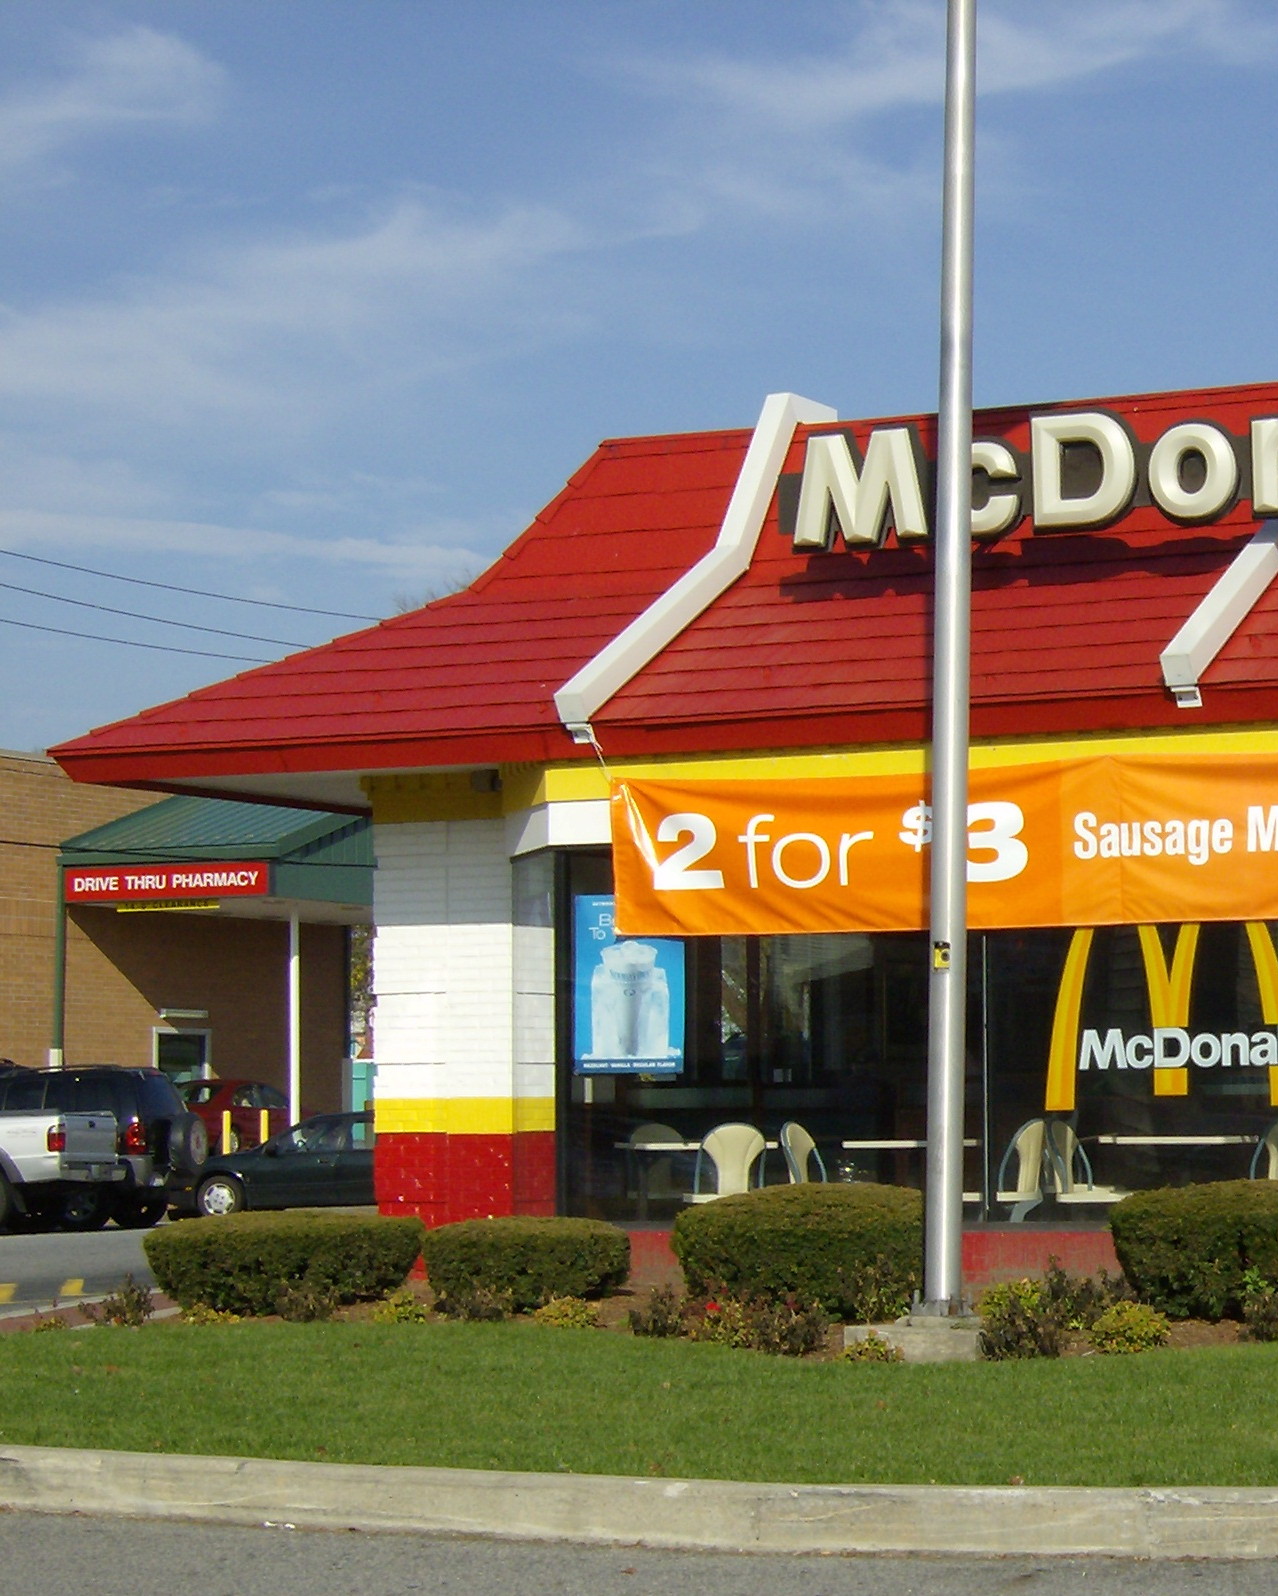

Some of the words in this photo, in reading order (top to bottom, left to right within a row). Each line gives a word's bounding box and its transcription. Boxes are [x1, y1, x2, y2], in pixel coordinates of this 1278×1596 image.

[653, 813, 725, 890] 2
[738, 814, 875, 889] for
[1073, 811, 1234, 866] Sausage
[74, 876, 119, 892] DRIVE
[125, 874, 167, 890] THRU
[172, 870, 259, 888] PHARMACY
